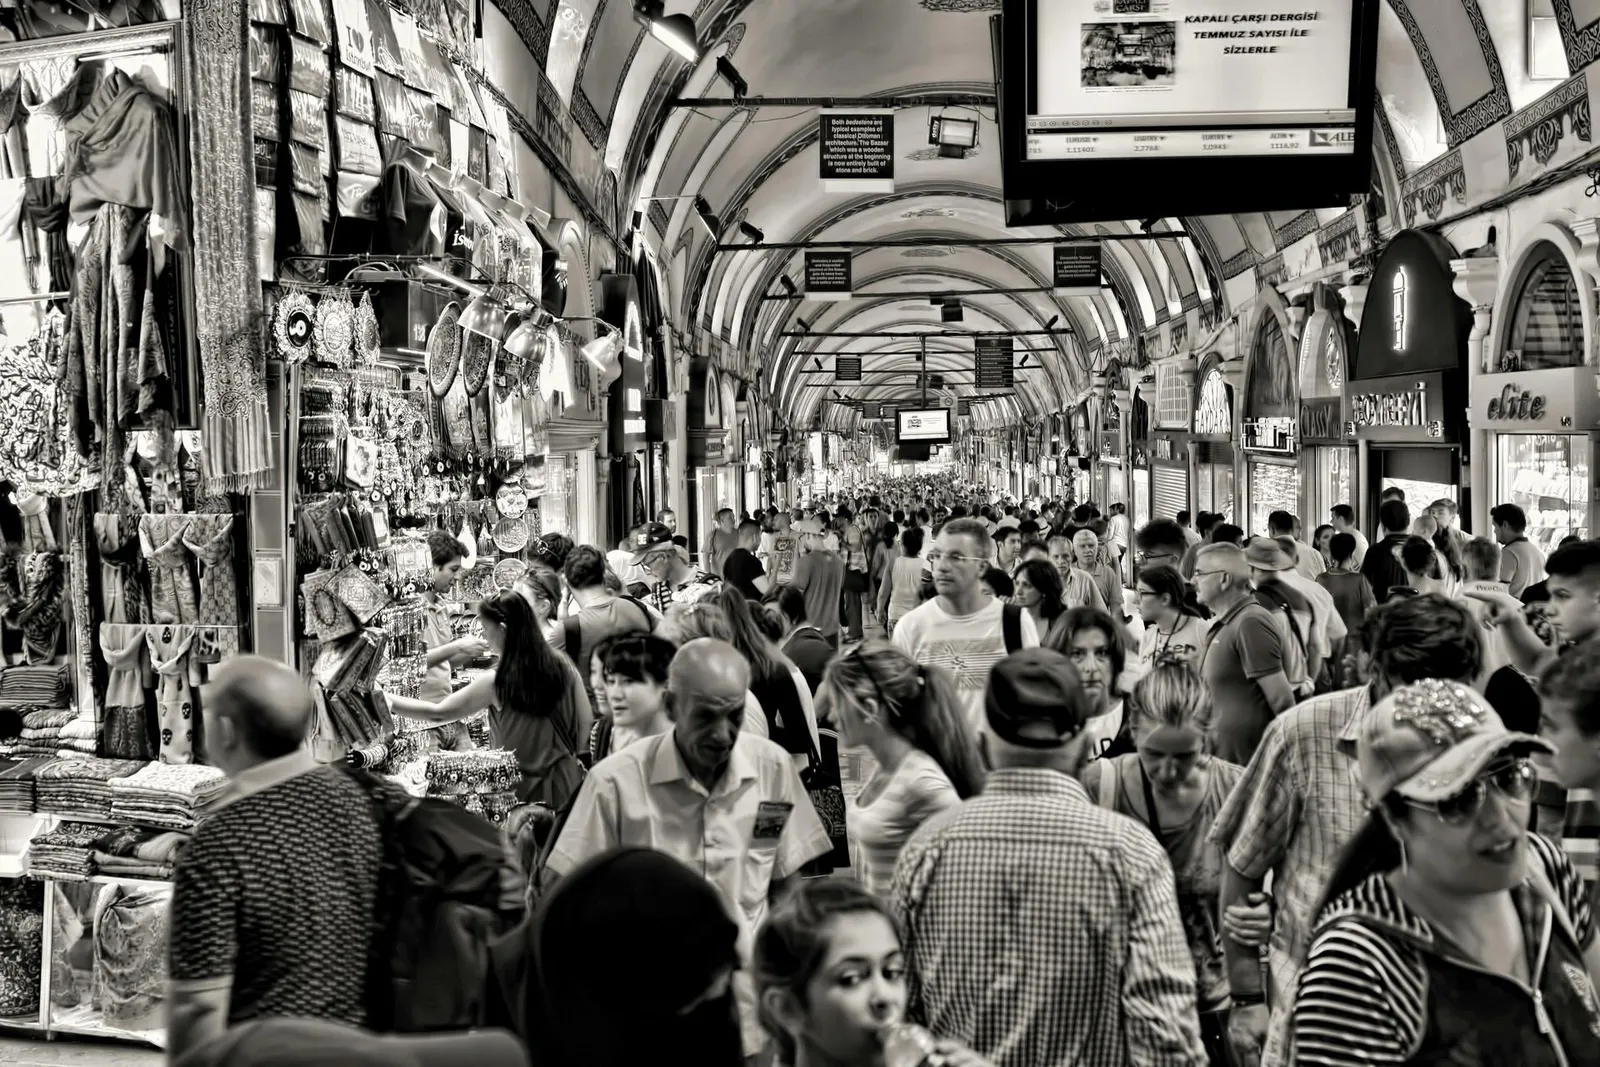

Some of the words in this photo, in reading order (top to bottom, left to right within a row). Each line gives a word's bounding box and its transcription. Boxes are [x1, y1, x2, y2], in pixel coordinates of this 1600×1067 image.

[1184, 15, 1228, 23] KAPALI
[1231, 14, 1266, 24] ÇARŞI
[1270, 11, 1318, 21] DERGİSİ
[1193, 30, 1245, 39] TEMMUZ
[1248, 29, 1286, 38] SAYISI
[1290, 27, 1309, 37] İLE
[1223, 45, 1277, 54] SİZLERLE
[1487, 383, 1546, 420] elite
